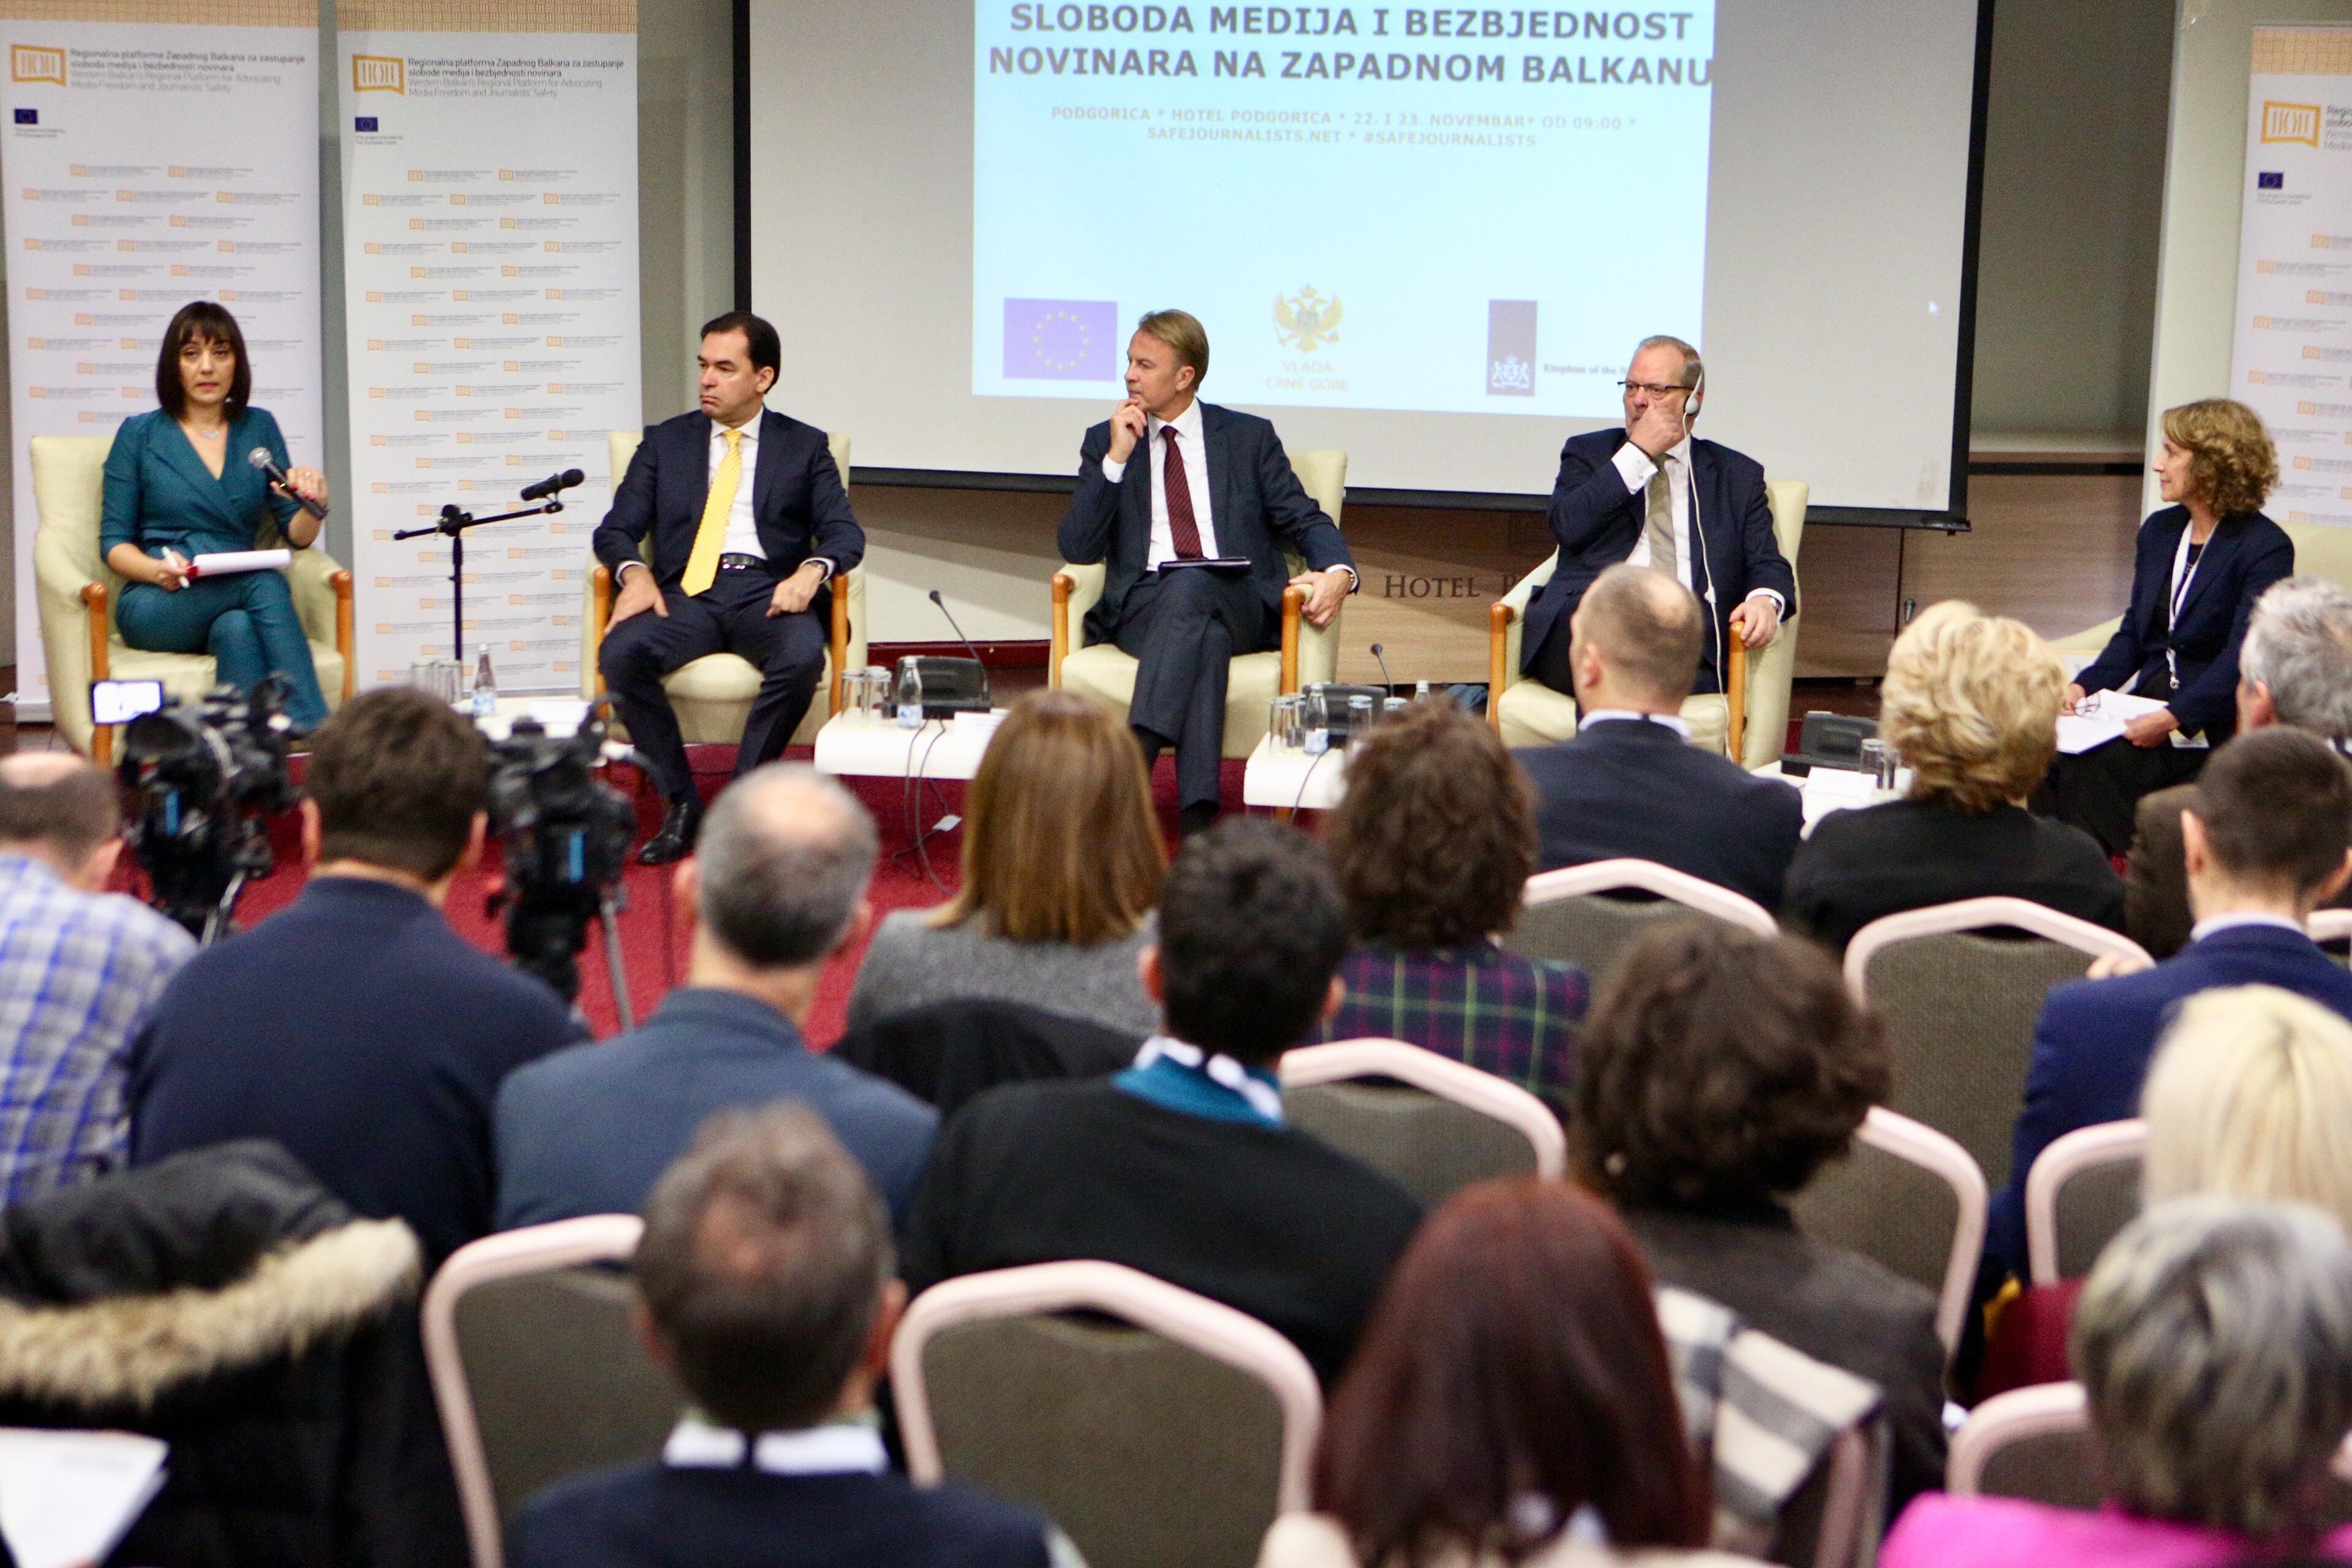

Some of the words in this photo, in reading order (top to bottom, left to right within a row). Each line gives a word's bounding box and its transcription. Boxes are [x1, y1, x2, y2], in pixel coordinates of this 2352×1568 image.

[1011, 3, 1194, 33] SLOBODA
[1210, 6, 1359, 36] MEDIJA
[1373, 9, 1390, 36] I
[1405, 9, 1694, 40] BEZBJEDNOST
[70, 48, 119, 60] Regionalna
[121, 50, 164, 60] platforma
[260, 53, 305, 64] zastupanje
[409, 58, 453, 69] Regionalna
[455, 58, 495, 68] platforma
[497, 58, 536, 69] Zapadnog
[538, 59, 570, 67] Balkana
[582, 59, 624, 69] zastupanje
[409, 68, 440, 77] slobode
[442, 69, 470, 78] medija
[475, 69, 526, 78] bezbjednosti
[527, 69, 562, 78] novinara
[989, 46, 1198, 77] NOVINARA
[1213, 50, 1266, 78] NA
[1280, 51, 1506, 82] ZAPADNOM
[1523, 55, 1713, 86] BALKANU
[561, 79, 602, 89] Advocating
[1052, 107, 1151, 121] PODGORICA
[1172, 108, 1225, 123] HOTEL
[1231, 110, 1332, 124] PODGORICA
[1354, 113, 1378, 125] 22.
[1385, 114, 1392, 125] I
[1398, 114, 1424, 126] 23.
[1542, 116, 1567, 129] OD
[1574, 117, 1622, 129] 09:00
[1147, 127, 1342, 143] SAFEJOURNALISTS.NET
[1364, 132, 1537, 147] #SAFEJOURNALISTS
[1282, 360, 1333, 373] VLADA
[1544, 363, 1586, 375] Kingdom
[1588, 365, 1599, 374] of
[1601, 365, 1616, 374] the
[1265, 377, 1305, 390] CRNE
[1308, 378, 1350, 391] GORE
[1383, 575, 1480, 598] HOTEL
